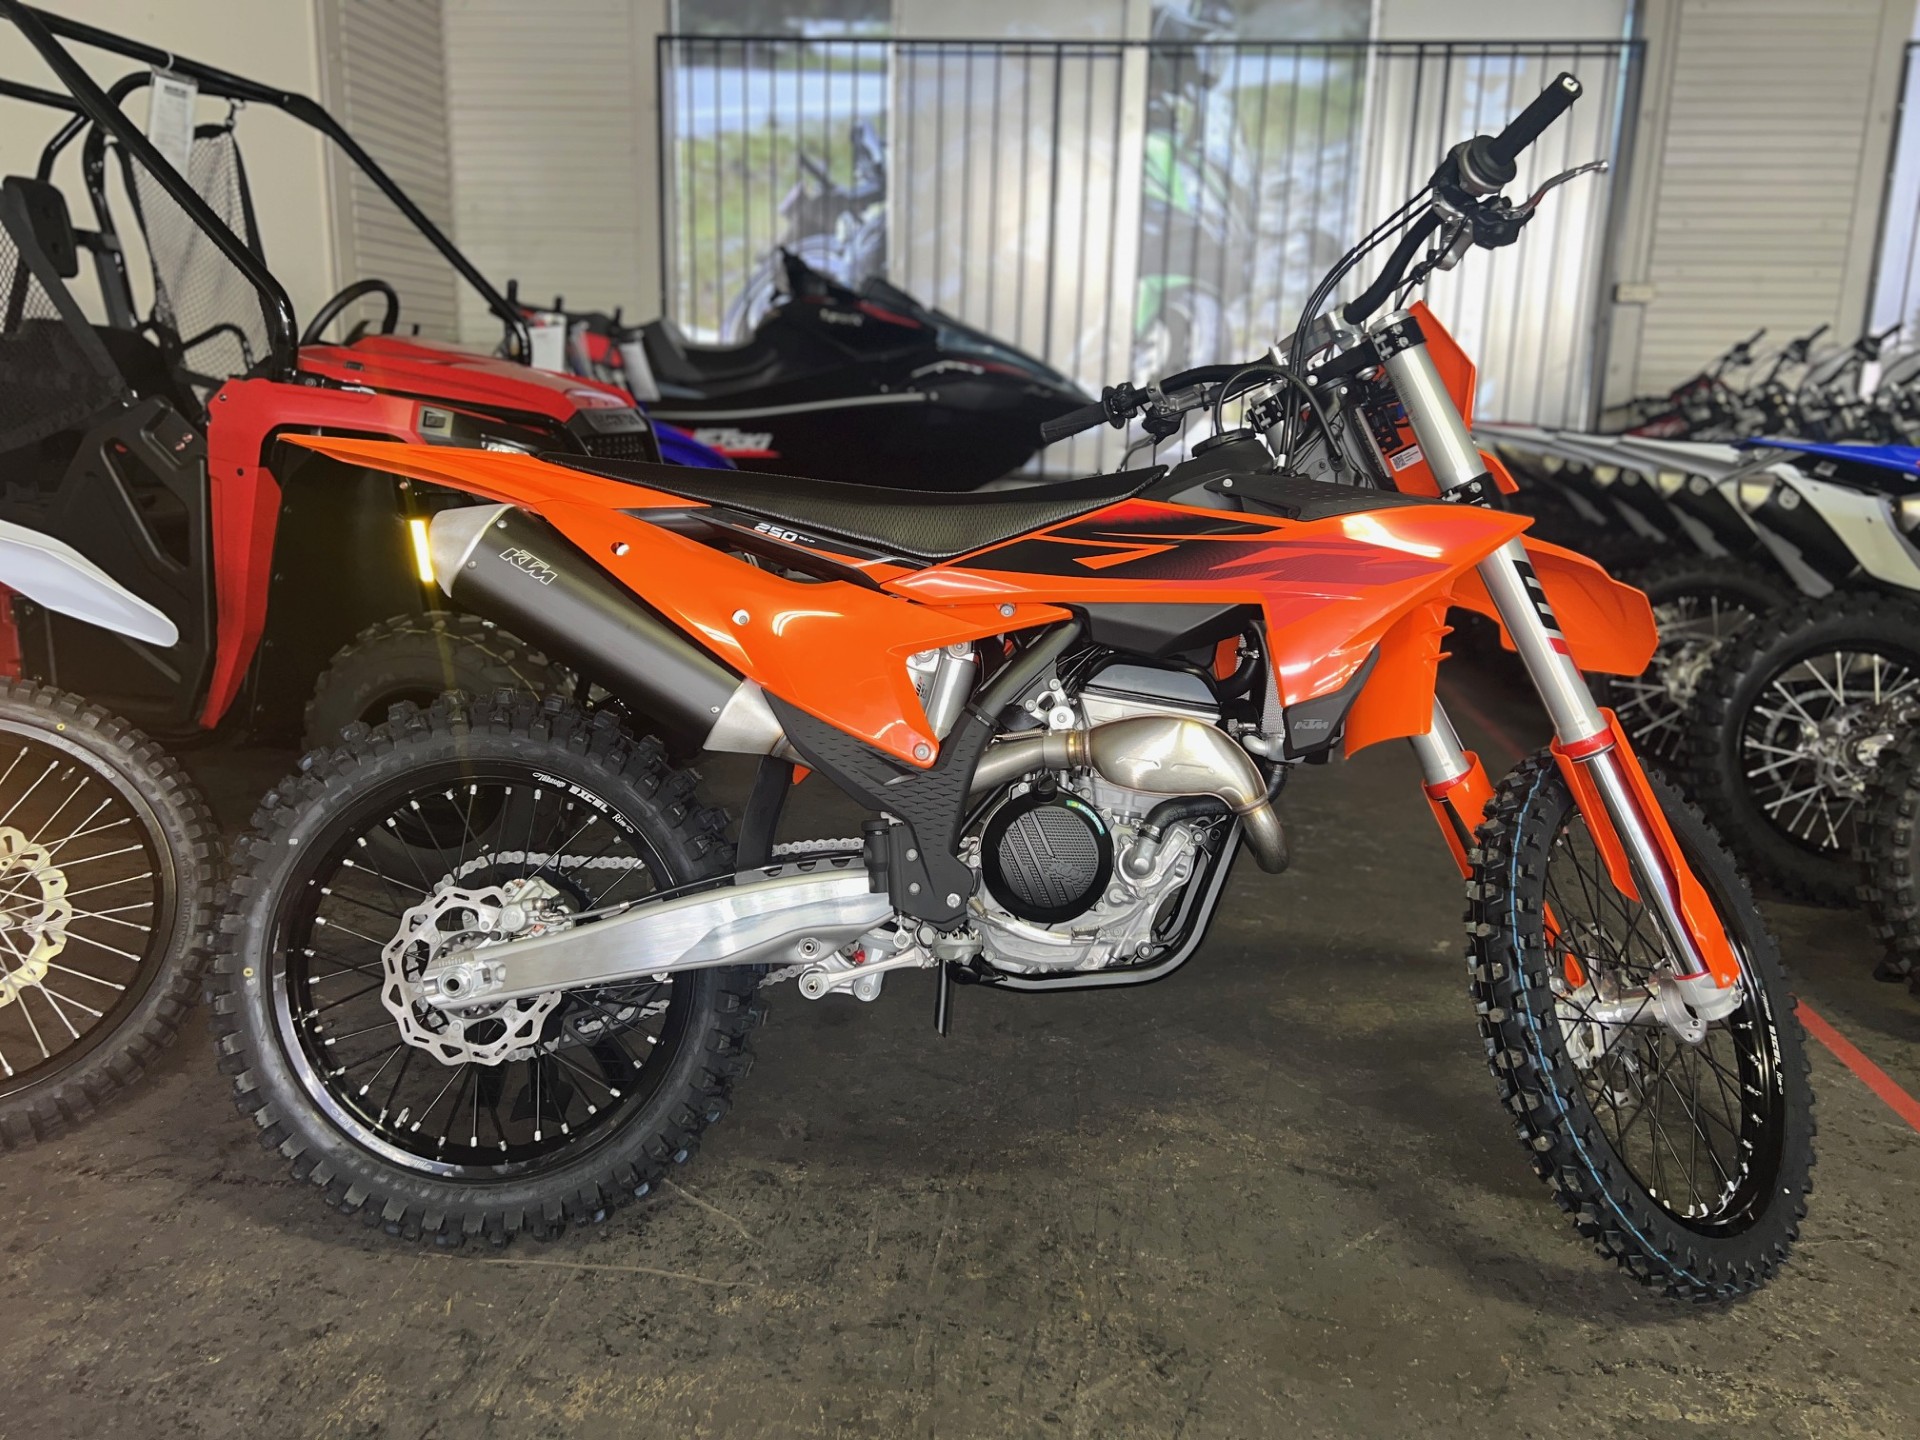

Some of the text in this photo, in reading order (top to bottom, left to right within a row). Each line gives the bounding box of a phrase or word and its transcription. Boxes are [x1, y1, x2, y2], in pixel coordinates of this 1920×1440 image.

[754, 522, 798, 543] 250
[499, 547, 558, 586] KTM
[1294, 718, 1330, 730] KTM
[568, 785, 608, 814] EXCEL
[1768, 1025, 1781, 1066] EXCEL
